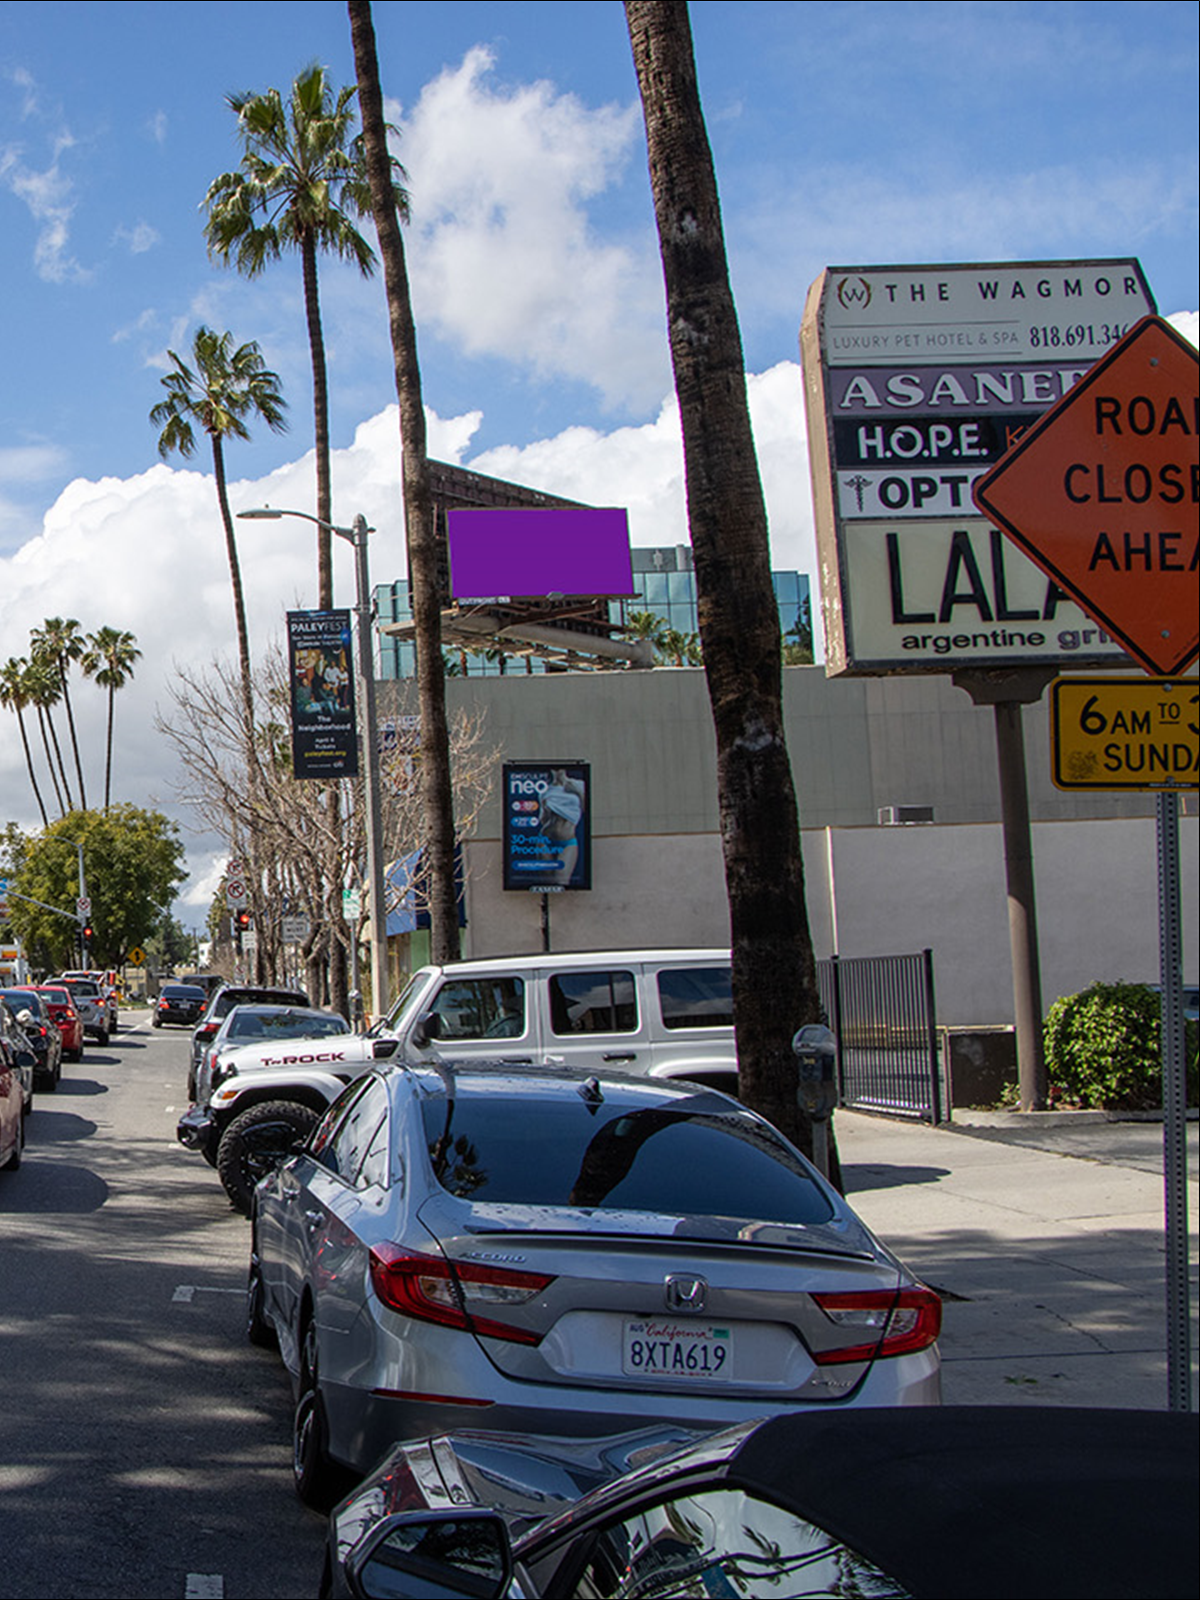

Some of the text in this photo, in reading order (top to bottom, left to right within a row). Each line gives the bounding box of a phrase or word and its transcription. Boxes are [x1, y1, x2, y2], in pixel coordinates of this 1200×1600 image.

[885, 283, 950, 302] THE
[978, 277, 1138, 300] WAGMOR
[833, 331, 1019, 349] LUXURY PET HOTEL & SPA
[1095, 396, 1199, 435] ROA
[857, 423, 989, 459] H.O.P.E.
[290, 621, 348, 632] PALEYFEST
[902, 629, 1046, 654] argentine
[1157, 702, 1181, 719] TO
[511, 780, 549, 794] neo
[511, 844, 564, 854] Procedure
[631, 1340, 726, 1371] 8XTA619
